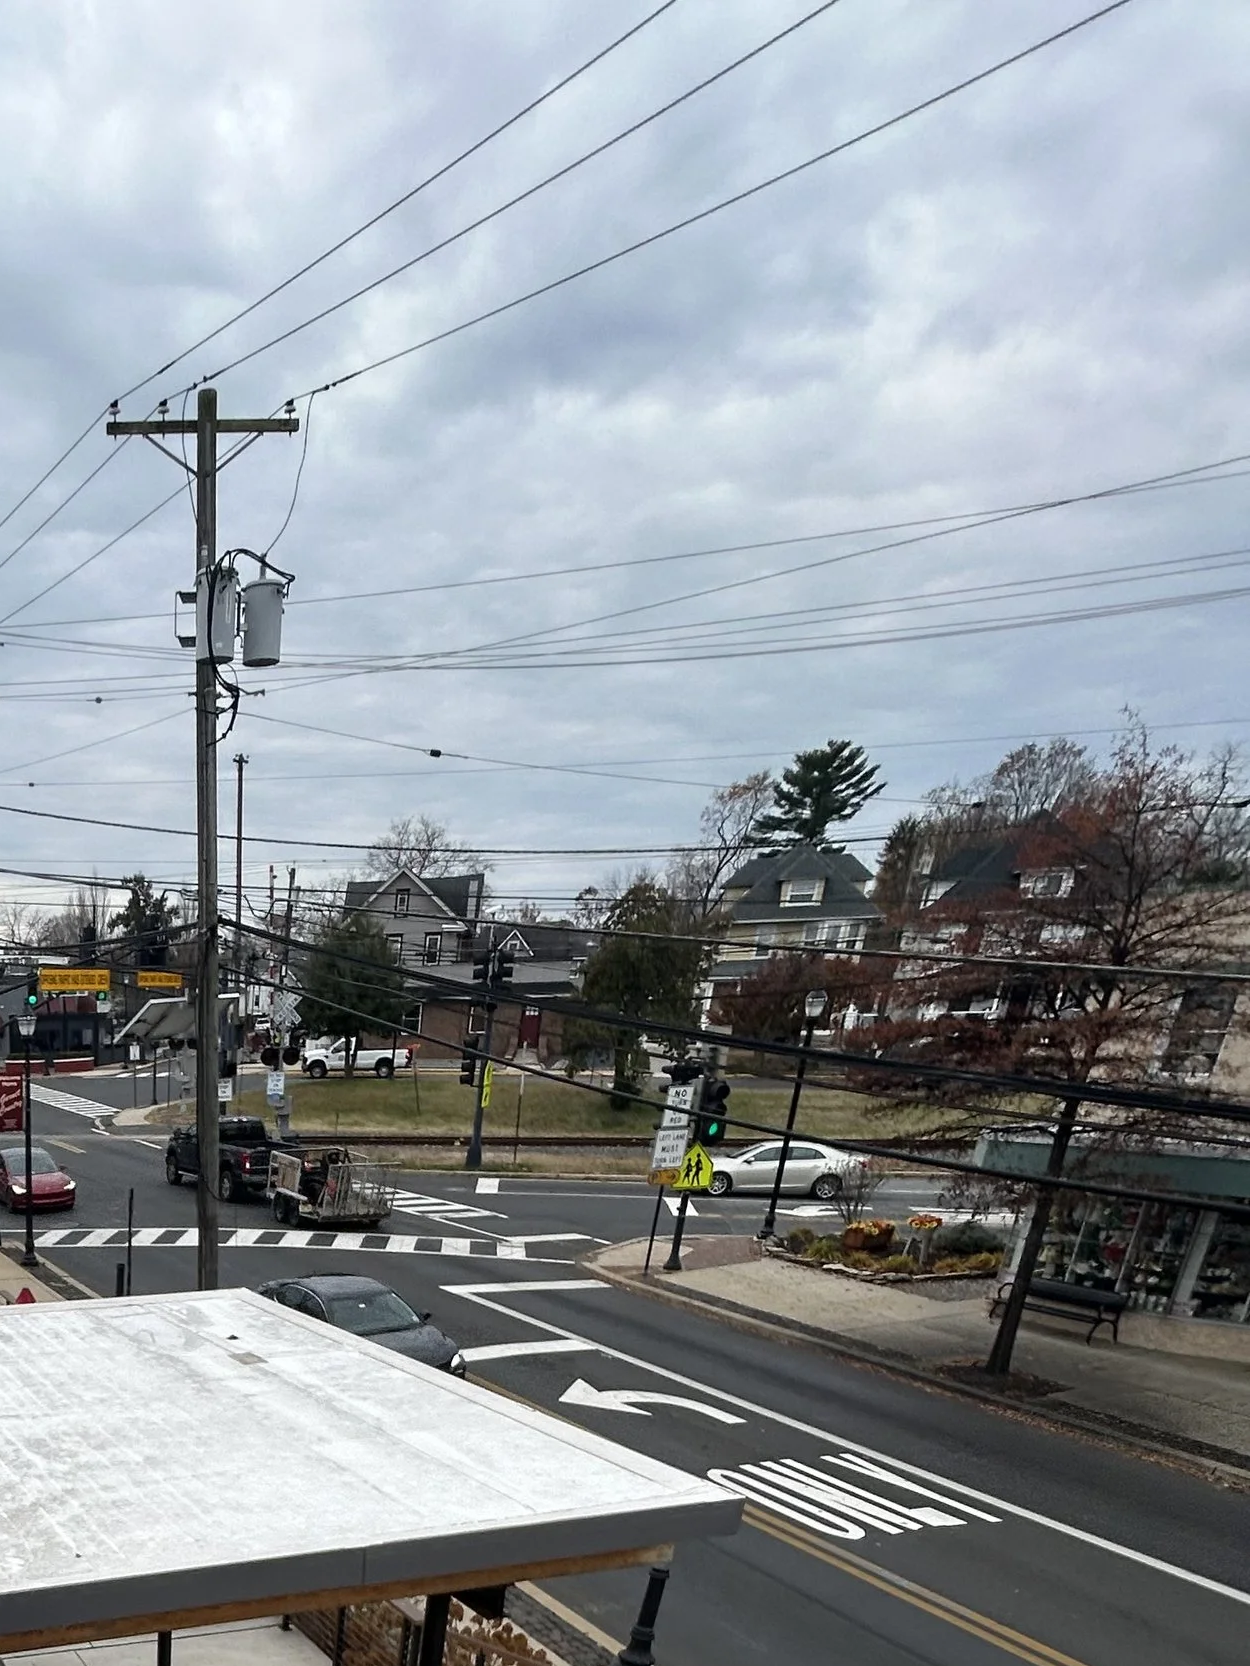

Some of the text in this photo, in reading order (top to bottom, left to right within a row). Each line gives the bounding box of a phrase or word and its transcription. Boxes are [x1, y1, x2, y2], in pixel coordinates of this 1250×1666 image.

[674, 1089, 688, 1098] NO
[661, 1144, 679, 1153] MUST
[707, 1453, 1003, 1540] ONLY
